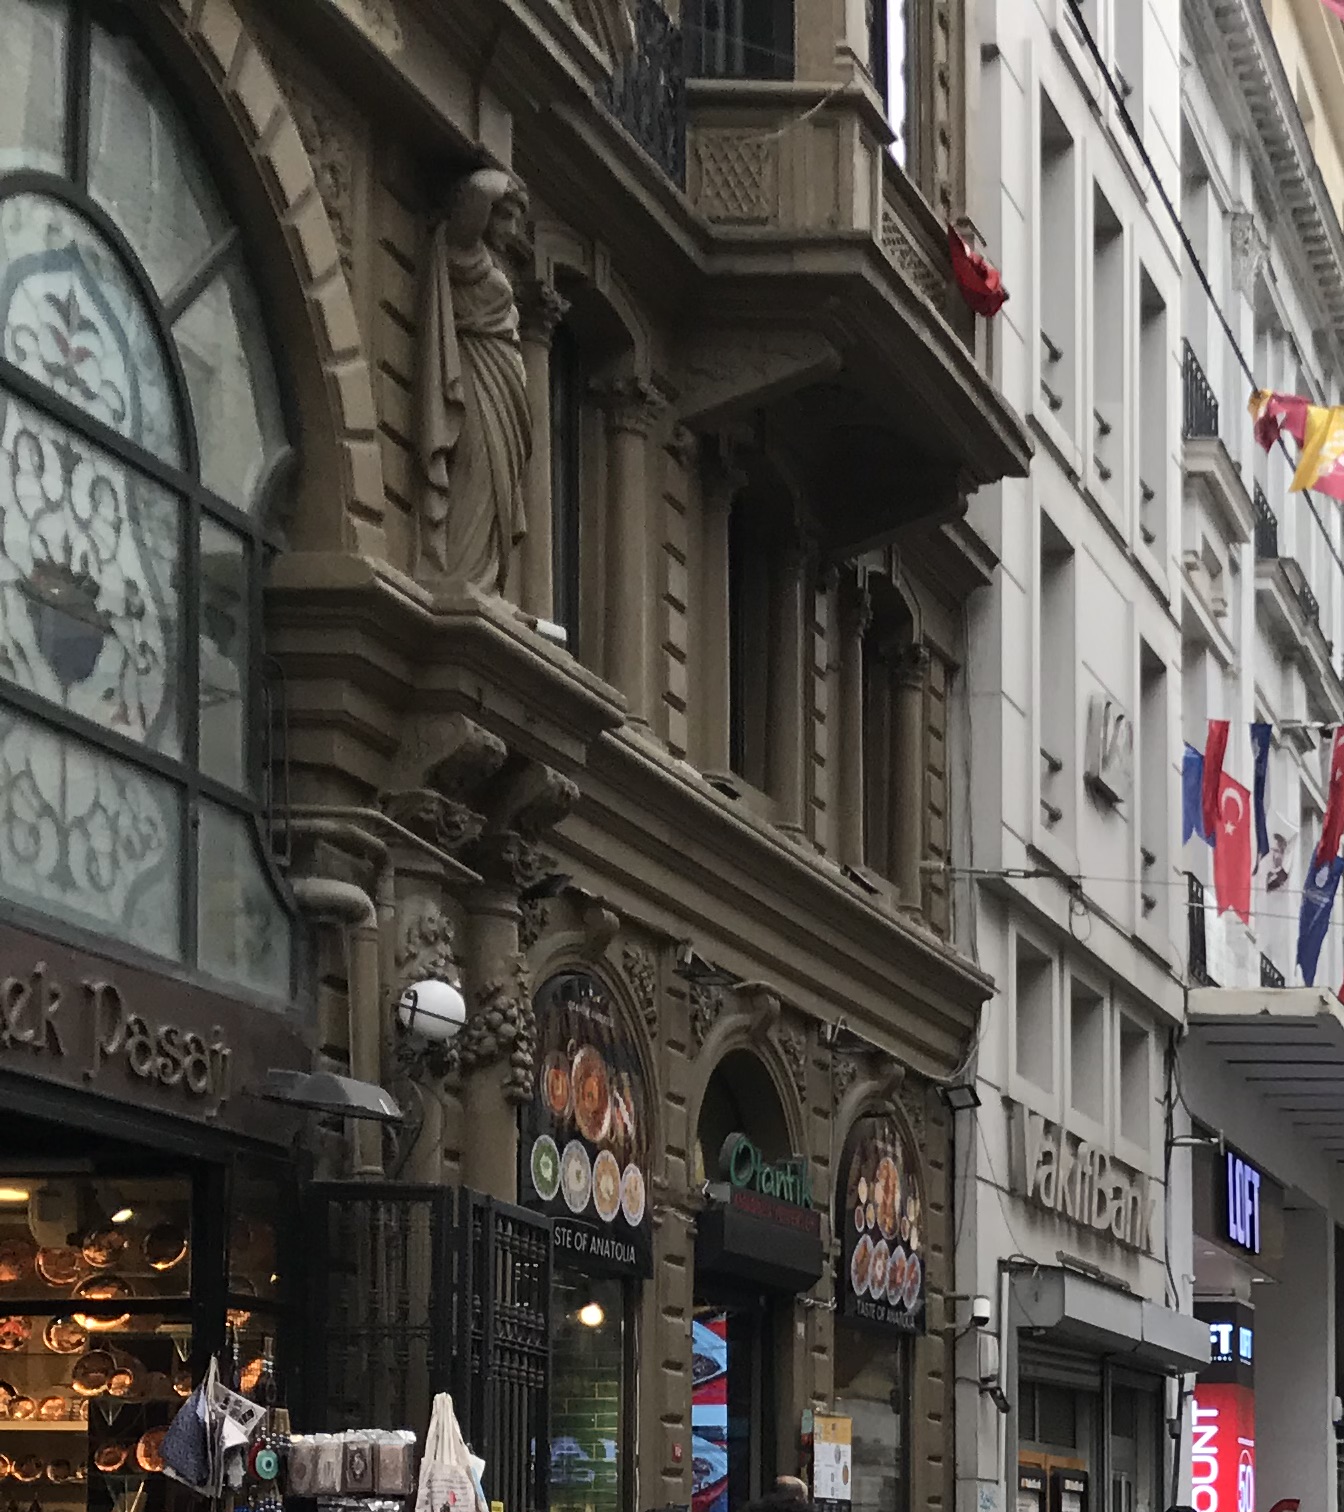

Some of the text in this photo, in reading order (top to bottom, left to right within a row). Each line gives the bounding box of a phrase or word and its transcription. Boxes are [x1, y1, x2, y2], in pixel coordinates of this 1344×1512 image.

[1227, 1151, 1261, 1255] LOFT
[574, 1231, 588, 1251] OF
[589, 1235, 636, 1265] ANATOLIA
